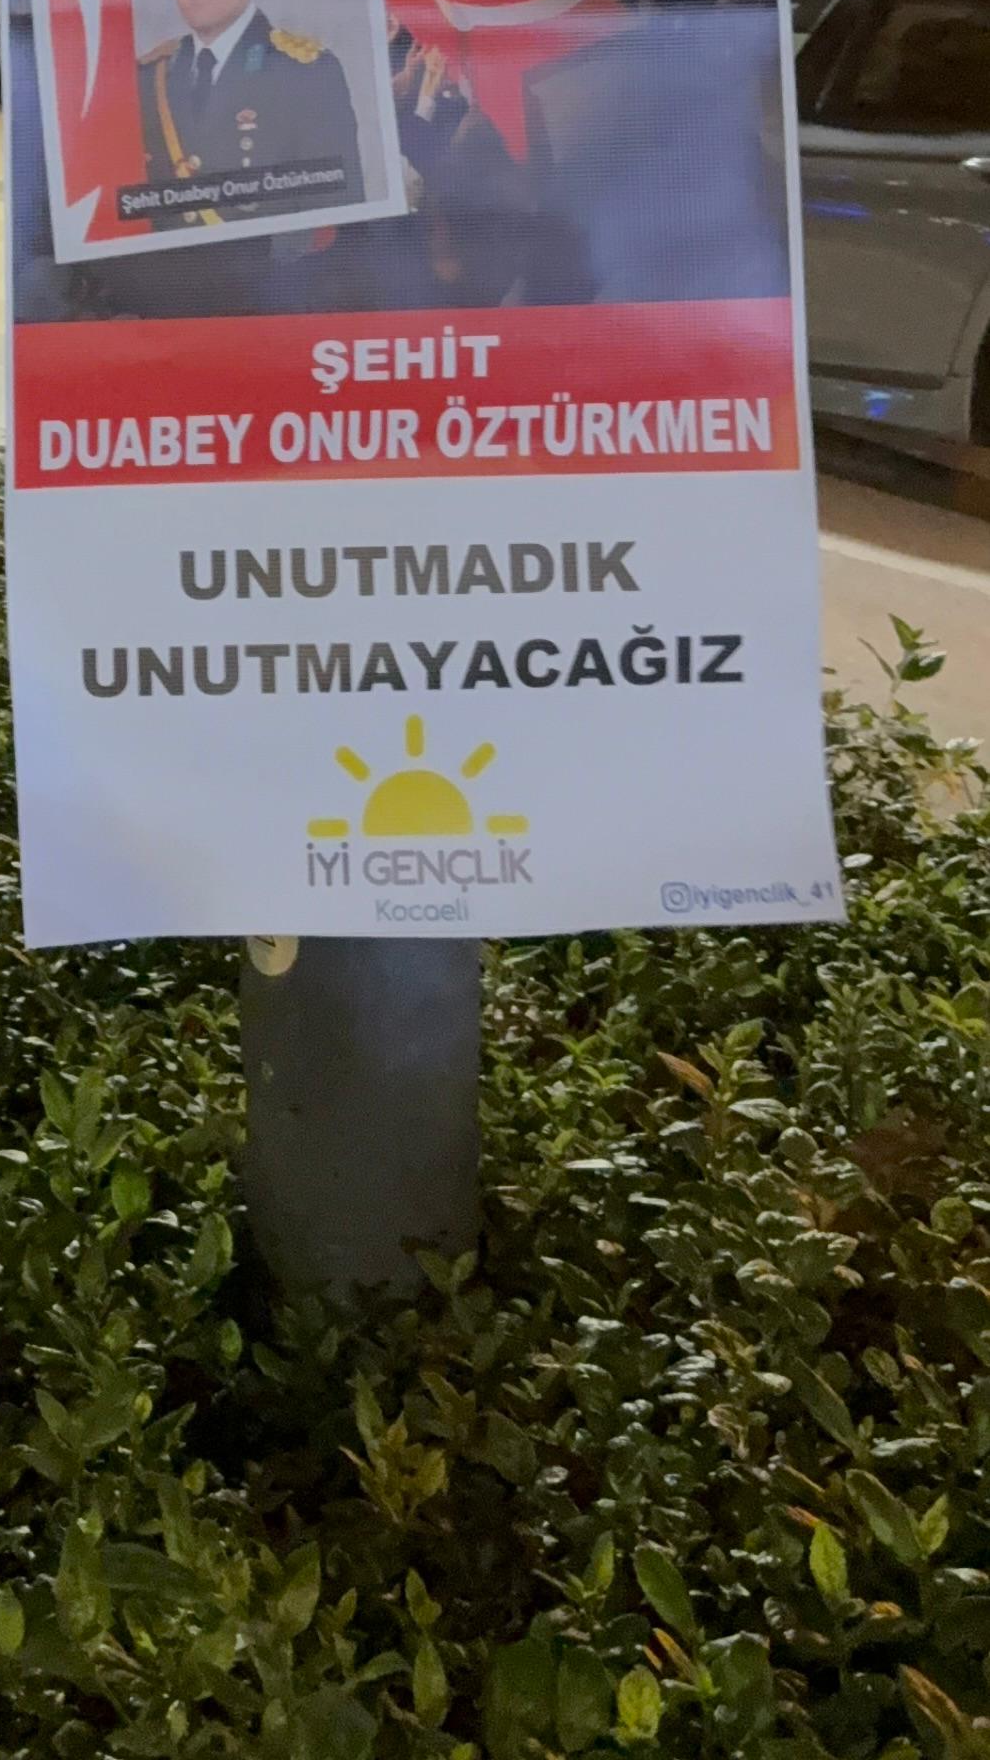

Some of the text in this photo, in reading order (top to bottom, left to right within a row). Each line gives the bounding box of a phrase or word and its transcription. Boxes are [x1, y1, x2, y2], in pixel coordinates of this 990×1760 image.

[121, 167, 345, 214] Şehit Duabey Onur Öztürkmen
[311, 326, 501, 394] ŞEHİT
[39, 393, 773, 470] DUABEY ONUR ÖZTÜRKMEN
[178, 540, 641, 601] UNUTMADIK
[80, 624, 744, 698] UNUTMAYACAĞIZ
[306, 839, 532, 891] İYİ GENÇLİK
[375, 898, 470, 922] Kocaeli
